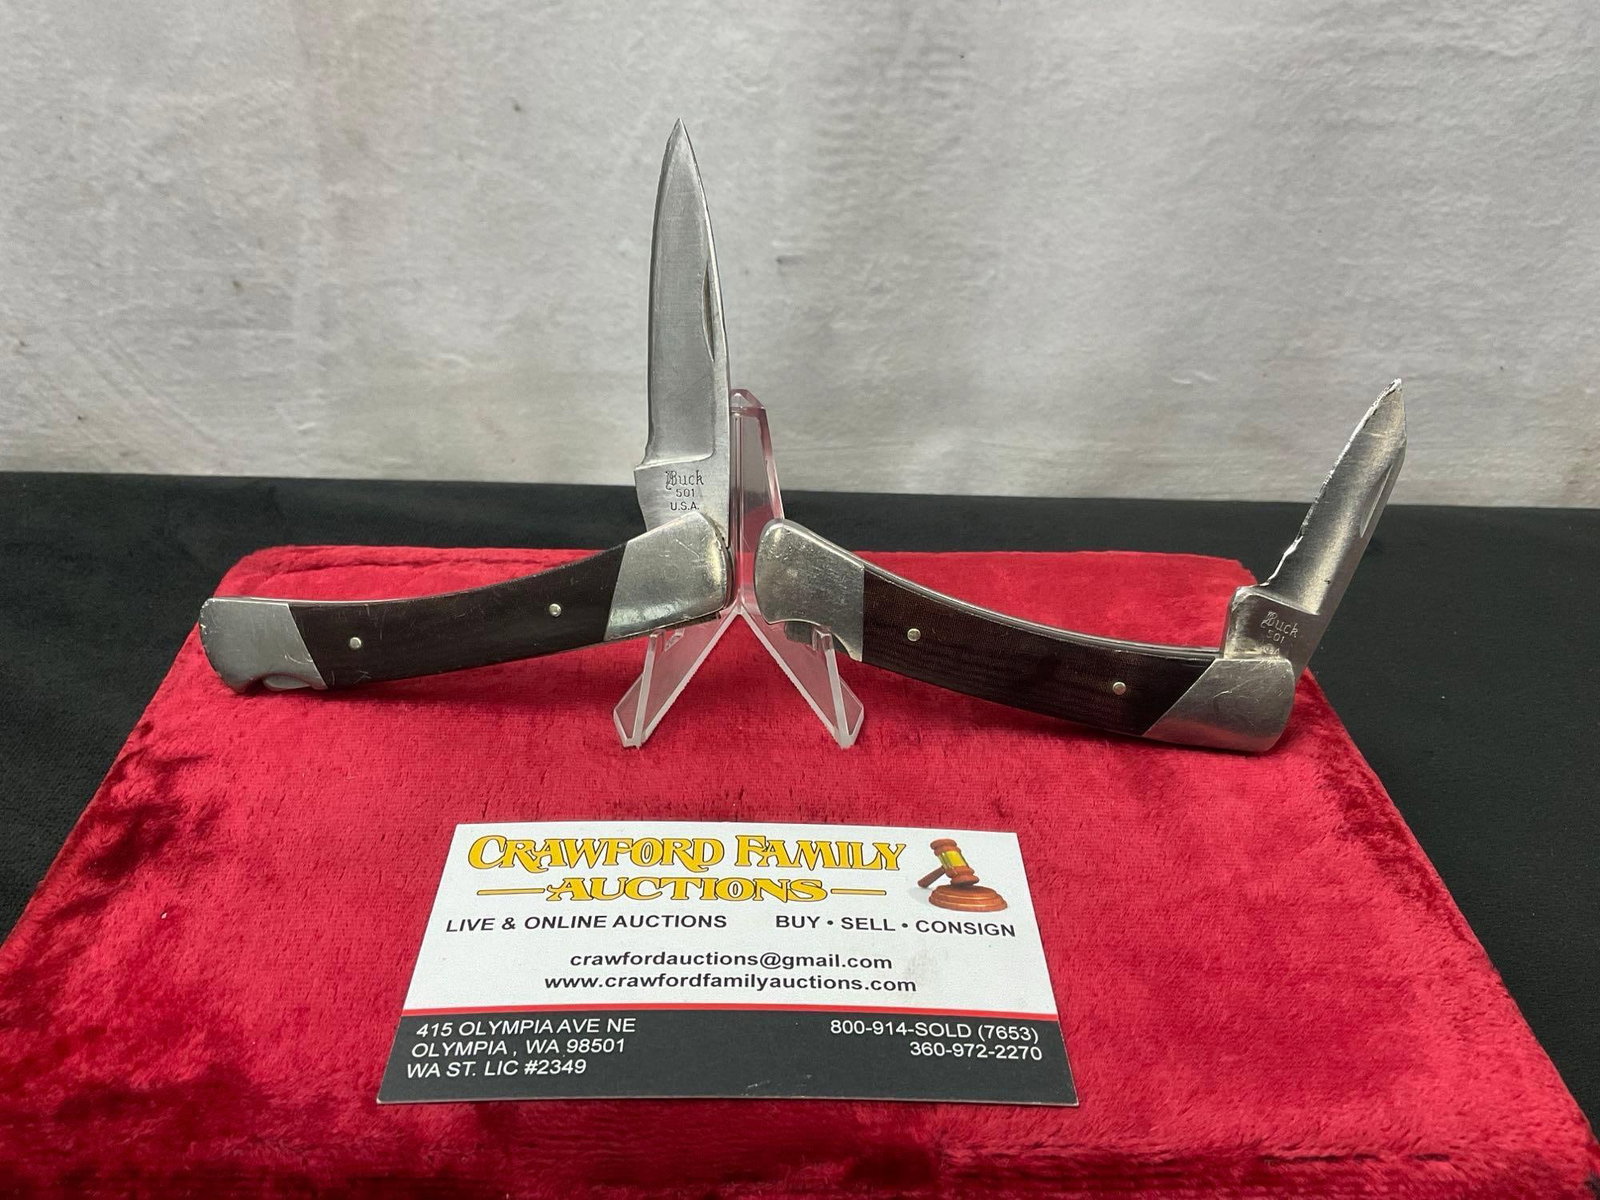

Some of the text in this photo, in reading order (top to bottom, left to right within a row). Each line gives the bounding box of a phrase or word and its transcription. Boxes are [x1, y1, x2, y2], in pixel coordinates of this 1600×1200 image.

[665, 469, 704, 490] Buck
[675, 488, 695, 498] 501
[670, 501, 700, 511] U.S.A.
[1261, 611, 1298, 638] Buck
[1266, 629, 1285, 644] 501
[468, 834, 907, 873] CRAWFORD FAMILY
[546, 877, 828, 903] AUCTIONS
[446, 914, 727, 932] LIVE & ONLINE AUCTIONS
[775, 915, 1016, 937] BUY SELL CONSIGN
[570, 951, 893, 972] crawfordauctions@gmail.com
[545, 973, 917, 992] www.crawfordfamilyauctions.com
[416, 1018, 636, 1038] 415 OLYMPIA AVE NE
[830, 1019, 1039, 1044] 800-914-SOLD (7653)
[411, 1040, 508, 1058] OLYMPIA
[526, 1039, 561, 1054] WA
[566, 1038, 625, 1054] 98501
[910, 1041, 1043, 1061] 360-972-2270
[407, 1059, 587, 1079] WA ST. LIC #2349
